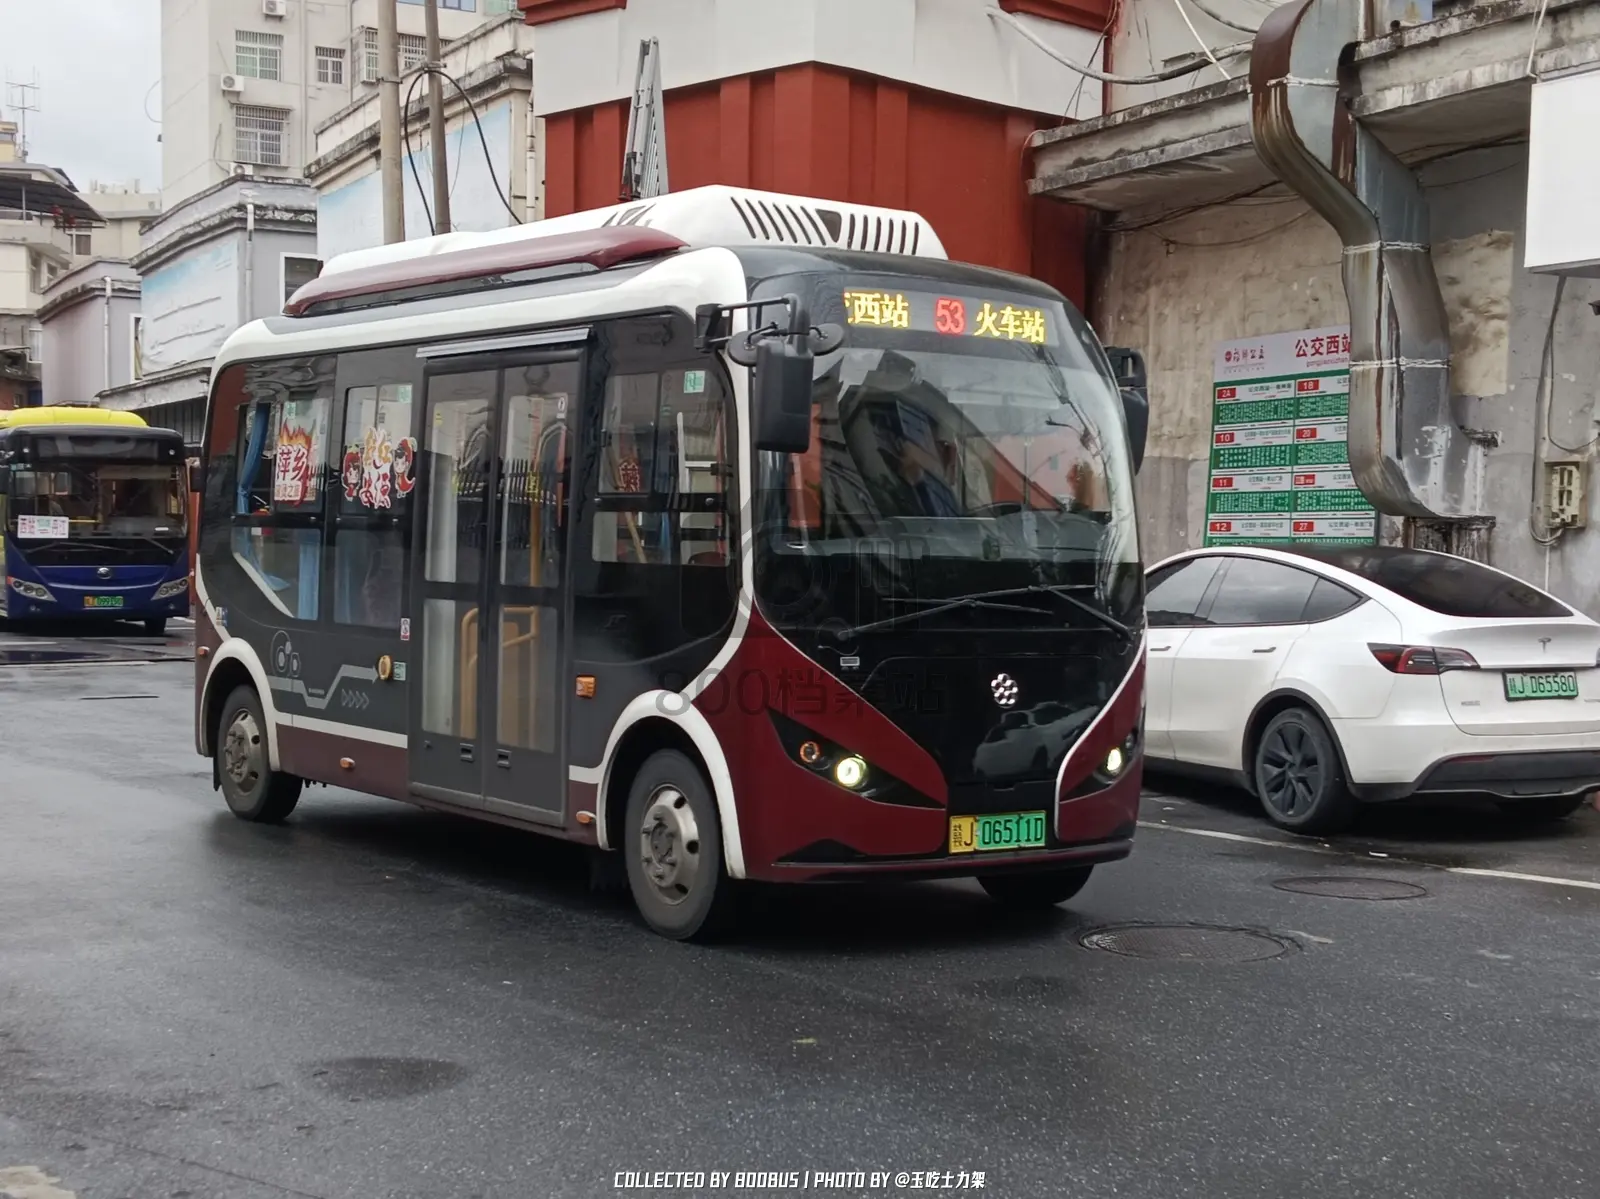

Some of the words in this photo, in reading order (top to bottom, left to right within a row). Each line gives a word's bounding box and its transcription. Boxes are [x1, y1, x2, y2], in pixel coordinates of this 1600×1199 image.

[844, 292, 909, 328] 西站
[936, 299, 965, 334] 53
[974, 303, 1045, 342] 火车站
[1295, 334, 1350, 358] 公交西站
